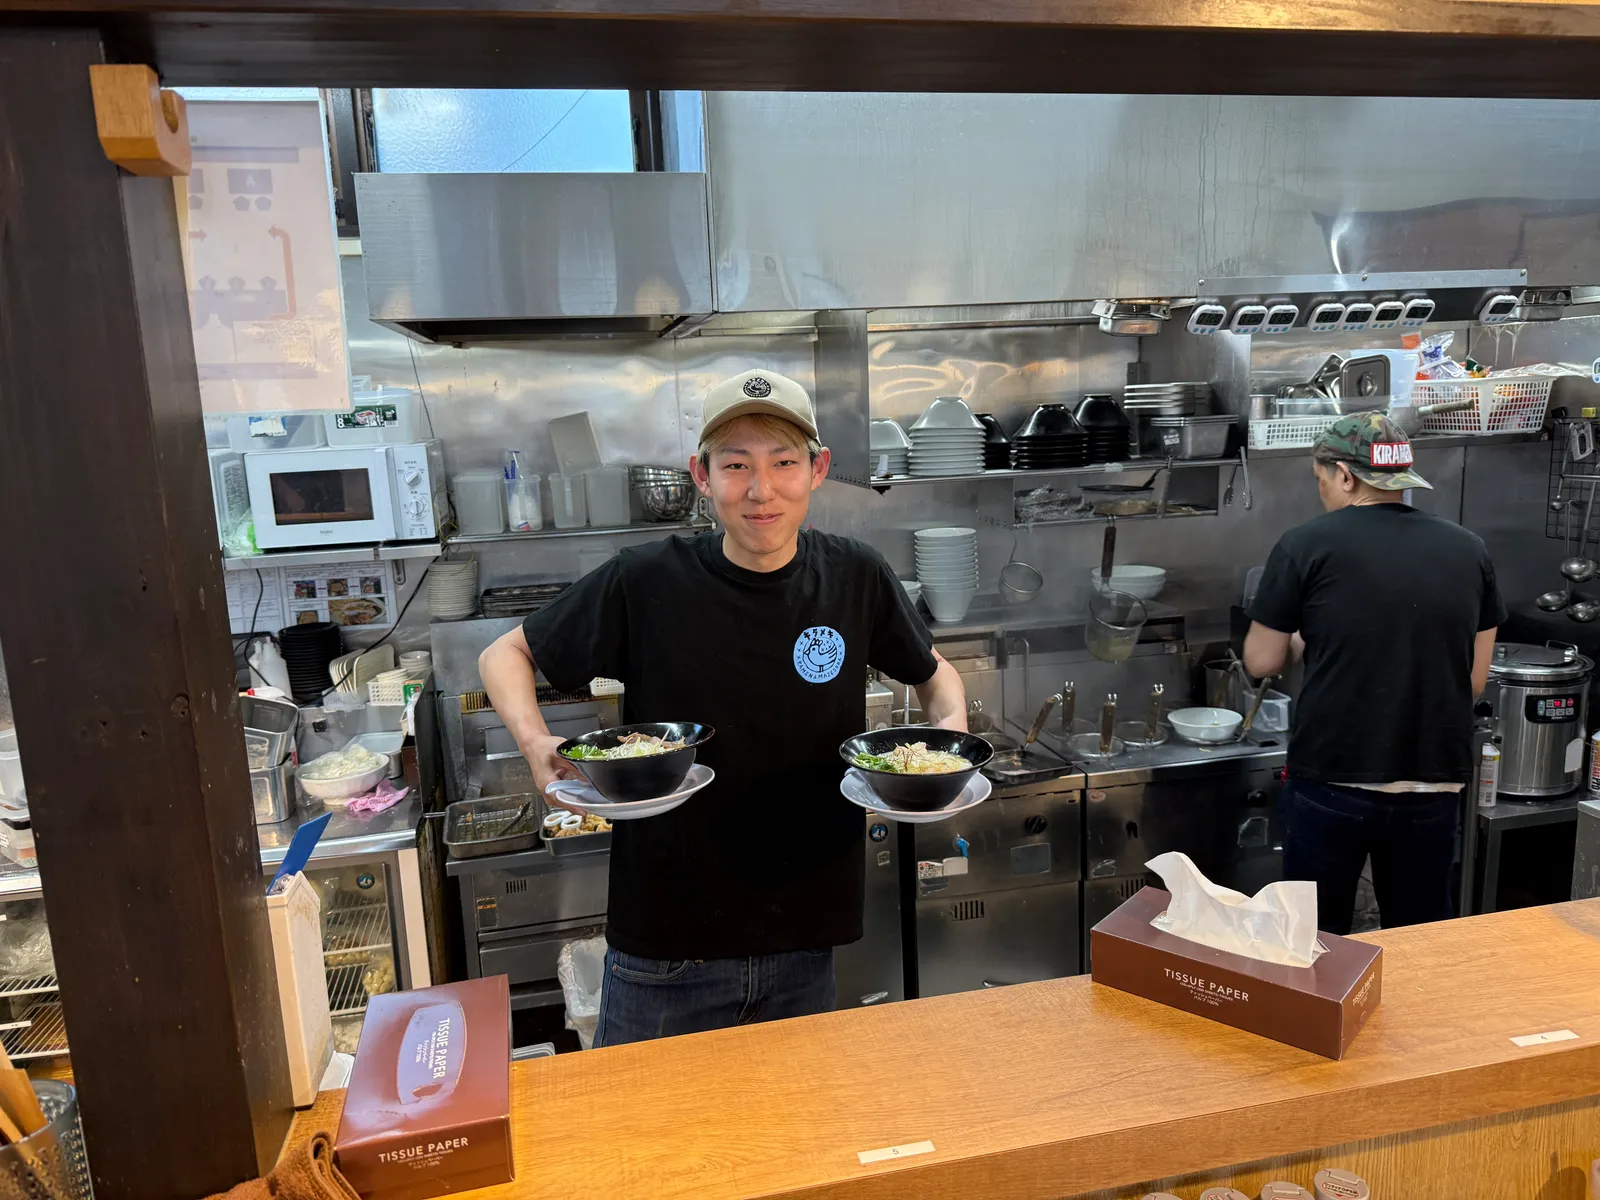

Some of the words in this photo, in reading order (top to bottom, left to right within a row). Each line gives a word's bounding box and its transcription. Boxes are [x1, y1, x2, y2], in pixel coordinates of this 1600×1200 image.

[245, 173, 256, 189] A
[803, 628, 833, 640] キラメキ
[1164, 968, 1205, 989] TISSUE
[1209, 982, 1249, 1002] PAPER
[437, 1017, 450, 1048] TISSUE
[433, 1048, 448, 1079] PAPER
[378, 1145, 424, 1163] TISSUE
[428, 1137, 469, 1153] PAPER
